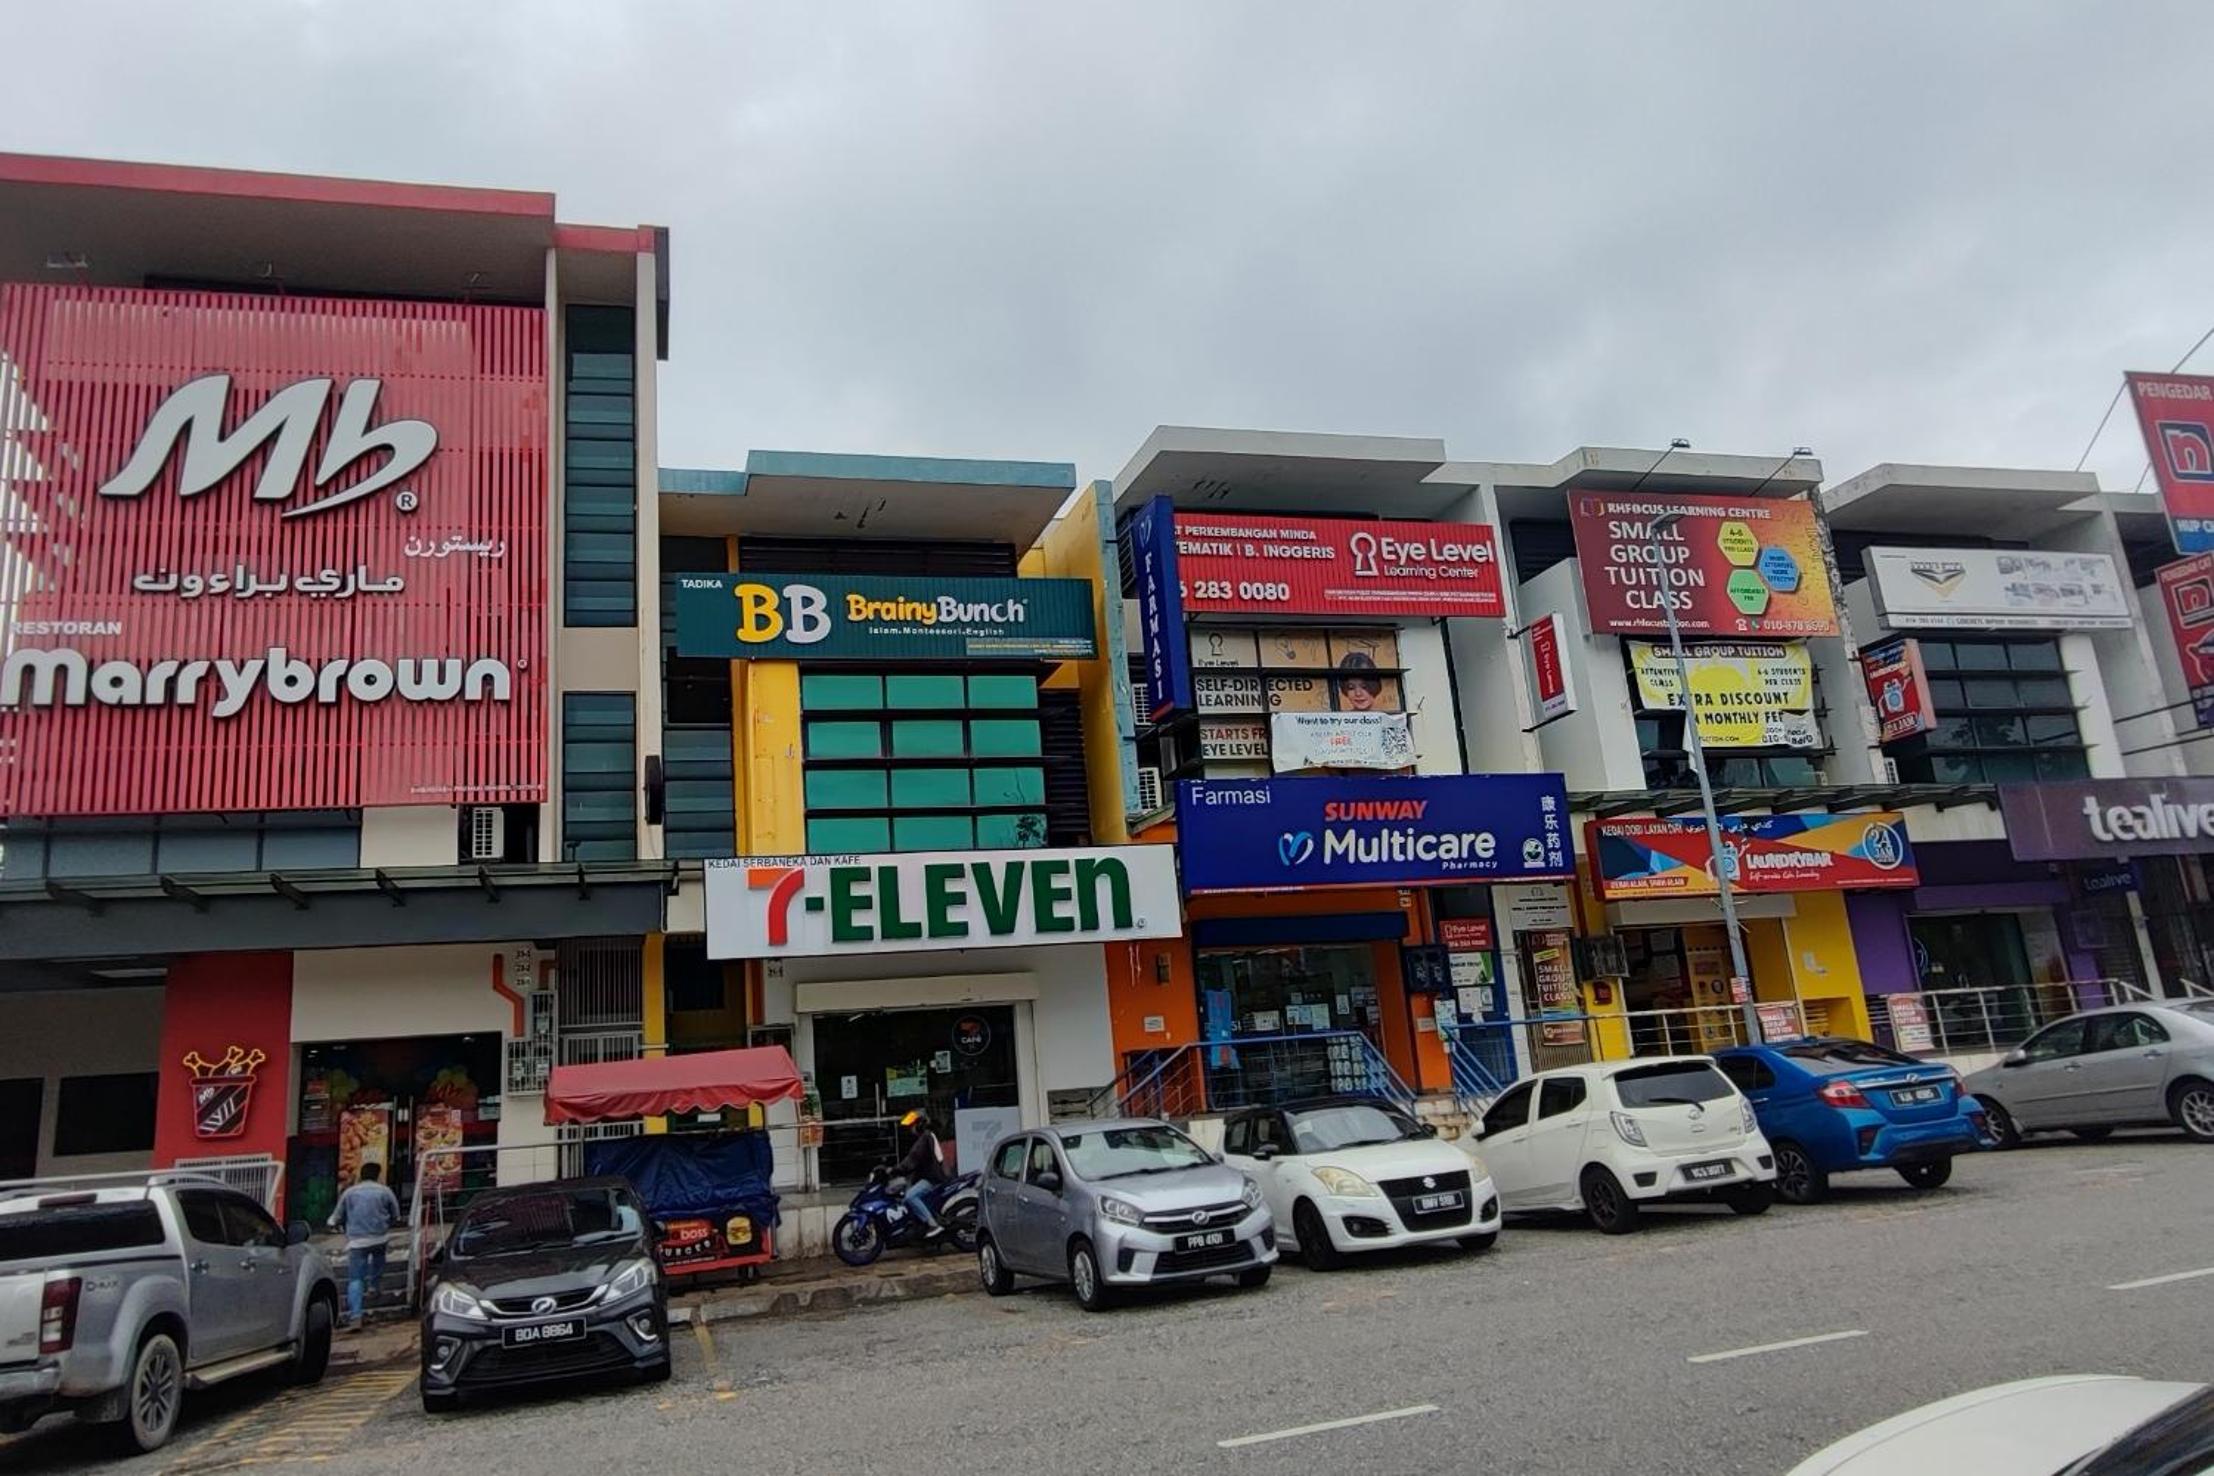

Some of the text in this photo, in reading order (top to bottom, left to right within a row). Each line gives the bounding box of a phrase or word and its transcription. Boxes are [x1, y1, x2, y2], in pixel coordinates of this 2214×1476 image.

[2137, 382, 2212, 400] PENGEDAR
[1728, 508, 1771, 519] CENTRE
[1185, 526, 1278, 539] PERKEMBANGAN
[1280, 529, 1317, 540] MINDA
[1264, 545, 1335, 559] INGGERIS
[1381, 537, 1495, 565] Eye Level
[1609, 544, 1690, 564] GROUP
[1384, 565, 1479, 579] Learning Center
[682, 579, 723, 589] TADIKA
[1194, 581, 1233, 599] 283
[1239, 582, 1290, 600] 0080
[1626, 590, 1693, 609] CLASS
[11, 621, 122, 635] RESTORAN
[1144, 551, 1163, 700] FARMASI
[1694, 648, 1736, 658] GROUP
[1738, 647, 1785, 657] TUITION
[1196, 679, 1313, 692] SELF-DIRECTED
[1199, 694, 1282, 707] LEARNING
[1720, 691, 1790, 705] DISCOUNT
[1704, 712, 1759, 725] MONTHLY
[1200, 728, 1249, 740] STARTS
[1203, 743, 1269, 755] EYE LEVEL
[1191, 786, 1271, 805] Farmasi
[1325, 800, 1428, 821] SUNWAY
[1323, 828, 1497, 865] Multicare
[708, 855, 861, 869] KEDAI SERBANEKA DAN KAFE
[1442, 860, 1498, 870] Pharmacy
[681, 1227, 709, 1240] boss
